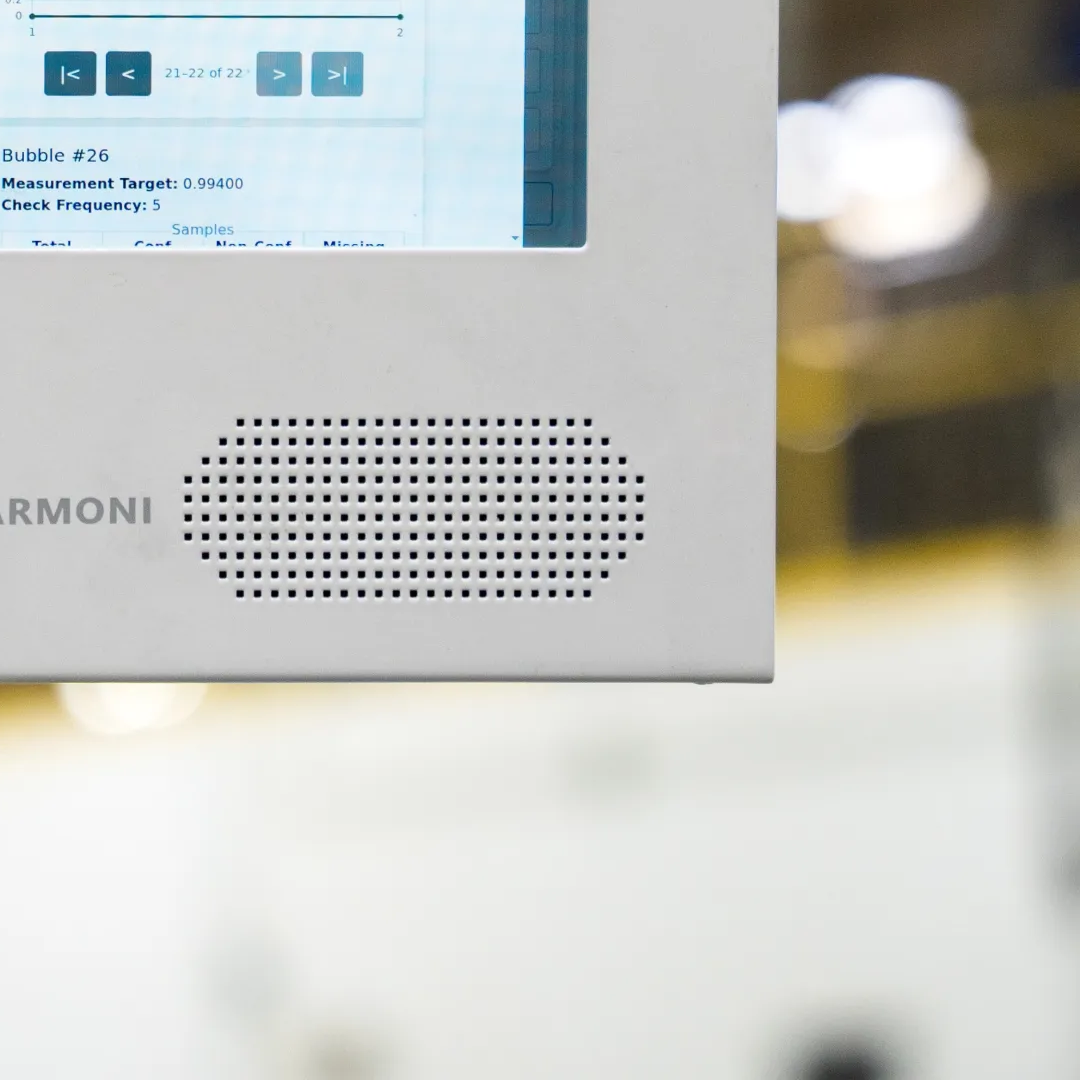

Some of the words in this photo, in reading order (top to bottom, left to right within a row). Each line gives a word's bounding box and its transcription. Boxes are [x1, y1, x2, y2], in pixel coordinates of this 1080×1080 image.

[15, 10, 23, 21] 0
[29, 27, 35, 37] 1
[396, 27, 404, 38] 2
[209, 67, 222, 79] of
[226, 67, 243, 79] 22
[2, 147, 65, 163] Bubble
[72, 148, 109, 163] #26
[1, 177, 115, 190] Measurement
[119, 177, 178, 192] Target:
[183, 177, 244, 190] 0.99400
[1, 198, 51, 211] Check
[56, 199, 147, 214] Frequency:
[152, 198, 161, 211] 5
[171, 223, 234, 238] Samples
